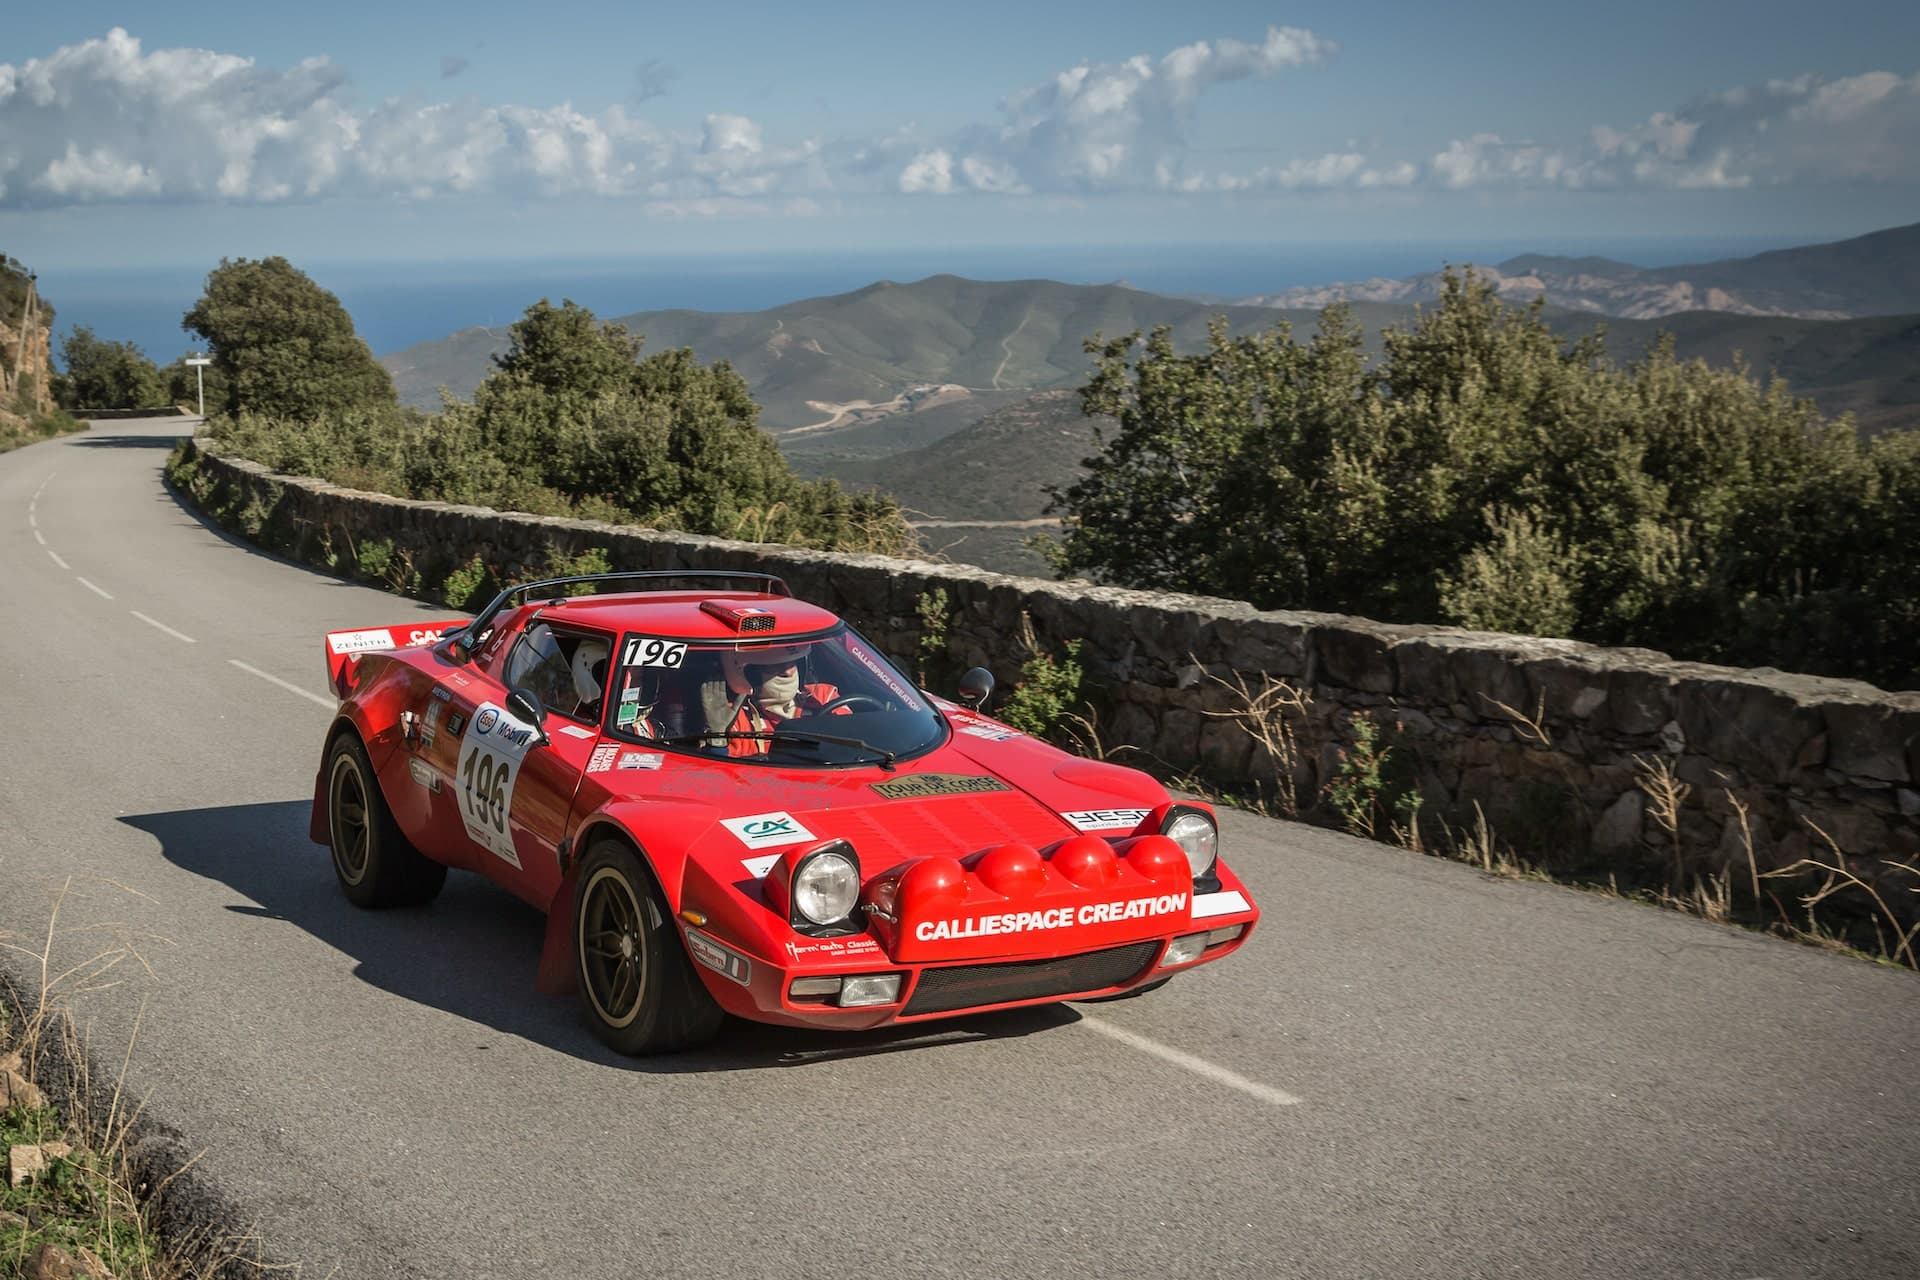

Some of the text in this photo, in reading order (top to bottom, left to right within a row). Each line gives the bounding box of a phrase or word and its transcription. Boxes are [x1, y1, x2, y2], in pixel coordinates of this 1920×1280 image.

[336, 639, 387, 649] ZENITH
[627, 640, 685, 667] 196
[851, 647, 892, 687] CALLIESPACE
[463, 746, 509, 834] 196
[875, 783, 922, 794] TOUR
[949, 777, 999, 788] CORSE
[916, 893, 1187, 941] CALLIESPACE CREATION
[847, 939, 878, 949] Classic
